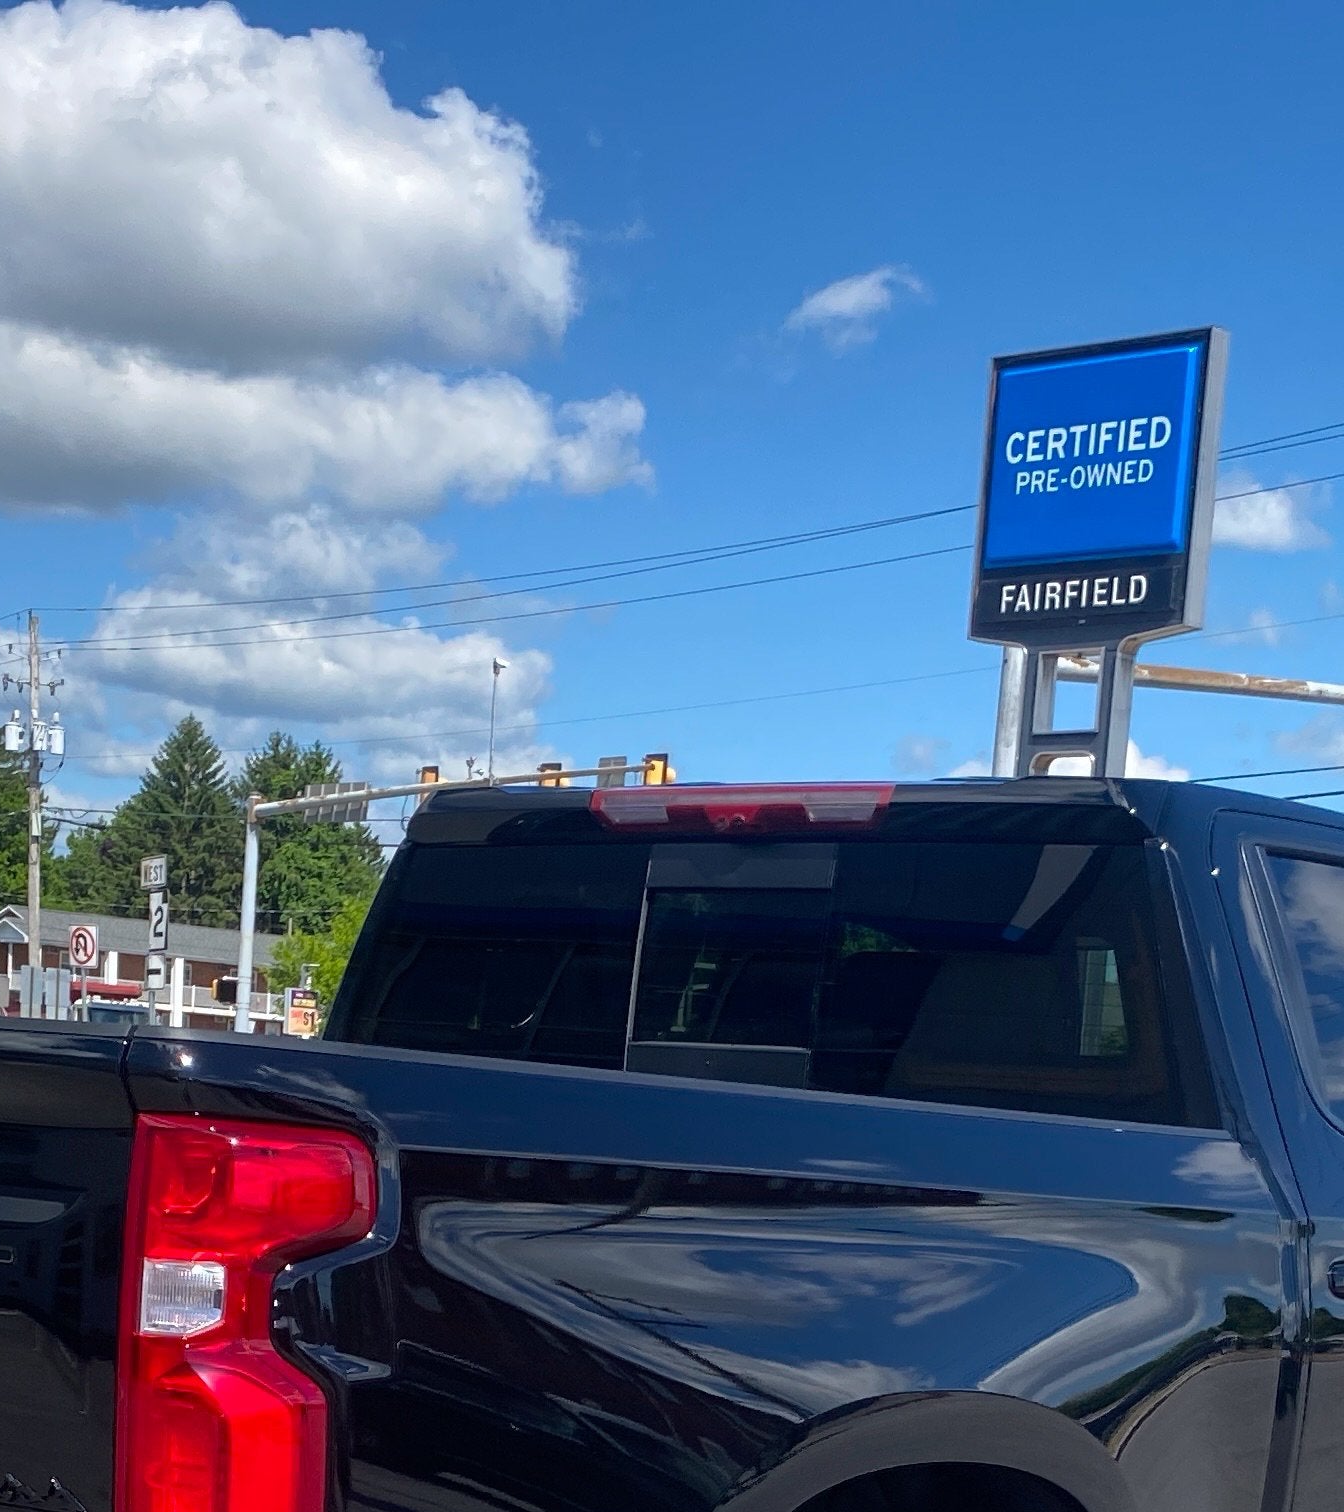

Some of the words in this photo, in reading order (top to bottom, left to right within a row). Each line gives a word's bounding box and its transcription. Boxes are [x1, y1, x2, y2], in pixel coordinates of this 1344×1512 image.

[1005, 415, 1173, 466] CERTIFIED
[1015, 460, 1154, 495] PRE-OWNED
[999, 574, 1149, 615] FAIRFIELD
